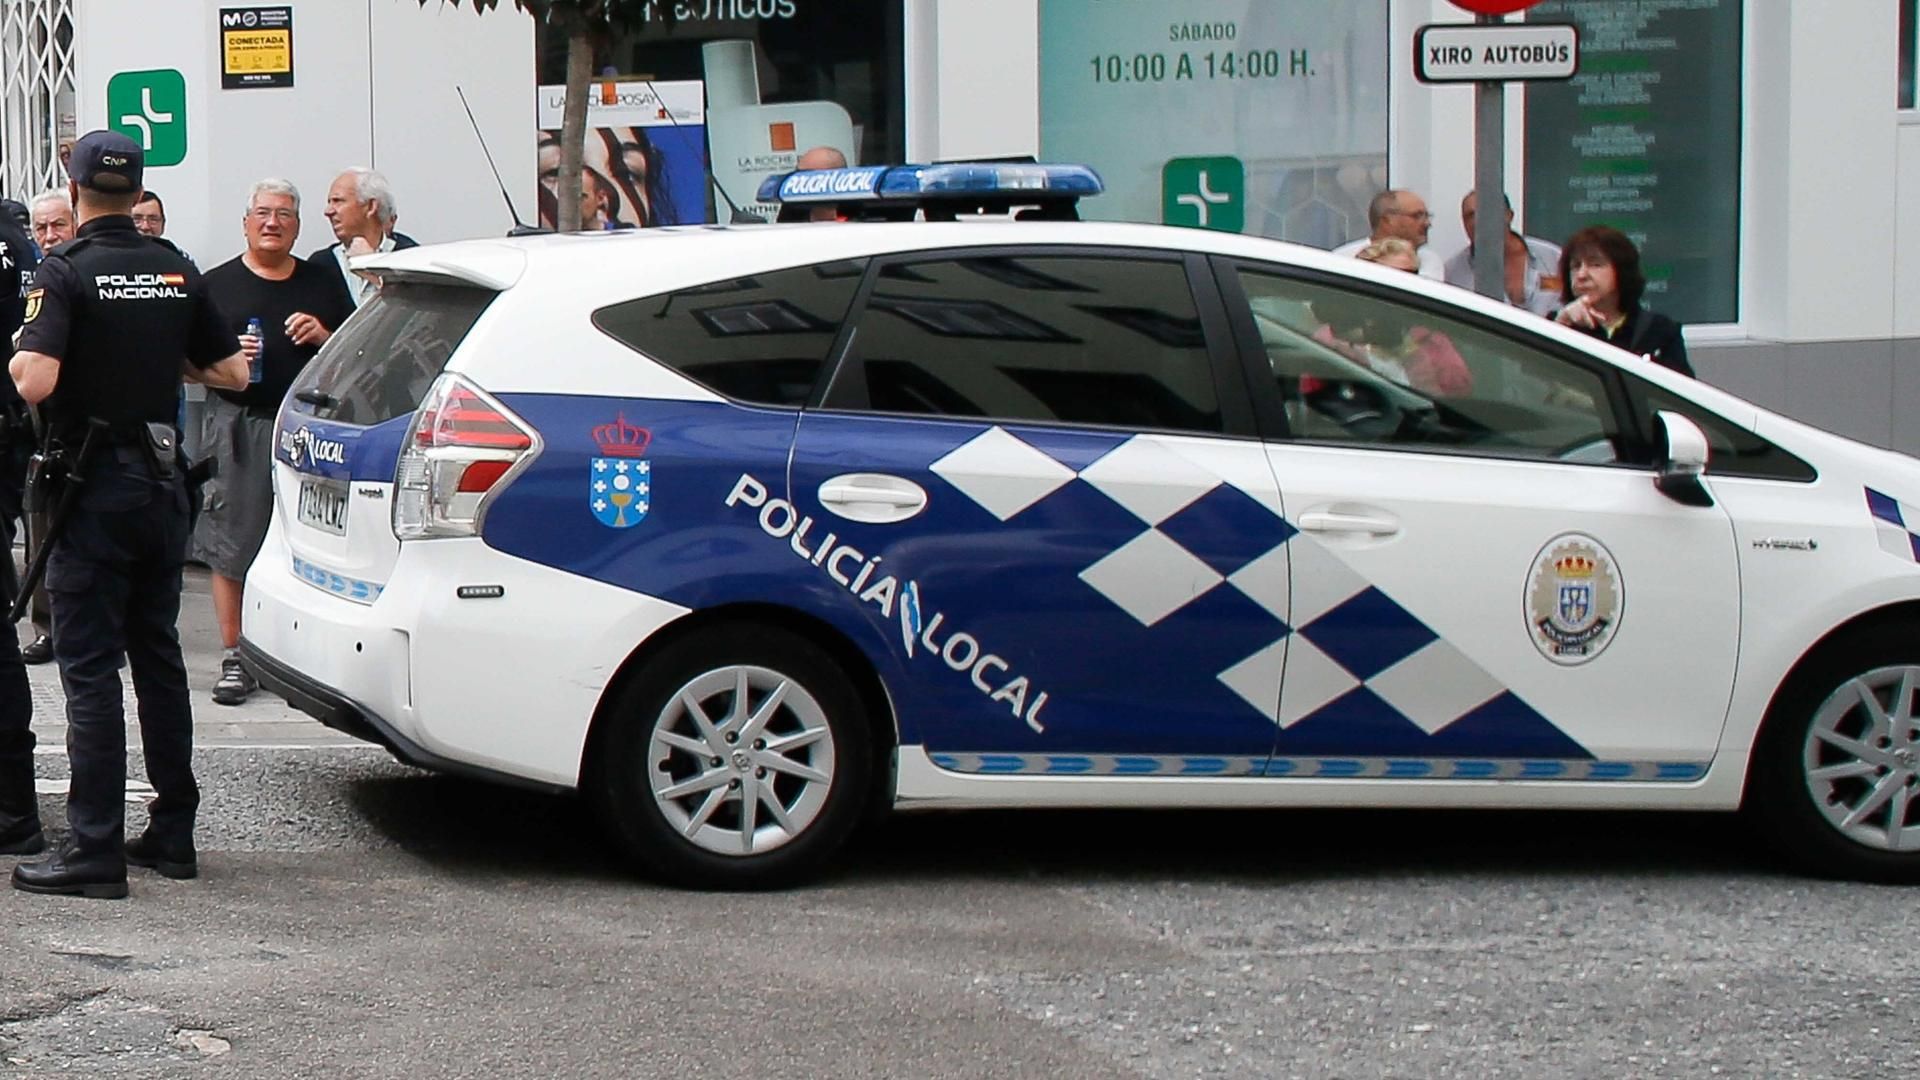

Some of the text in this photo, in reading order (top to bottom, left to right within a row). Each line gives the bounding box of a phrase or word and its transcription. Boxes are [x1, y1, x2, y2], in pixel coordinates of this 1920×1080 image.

[228, 36, 285, 46] CONECTADA
[1430, 46, 1473, 65] XIRO
[1483, 40, 1569, 64] AUTOBÚS
[1090, 49, 1316, 83] 10:00 A 14:00 H.
[102, 155, 128, 167] CNP
[834, 171, 874, 192] LOCAL
[95, 274, 168, 287] POLICIA
[99, 286, 188, 300] NACIONAL
[316, 439, 344, 464] LOCAL
[725, 473, 1048, 734] POLICÍA LOCAL
